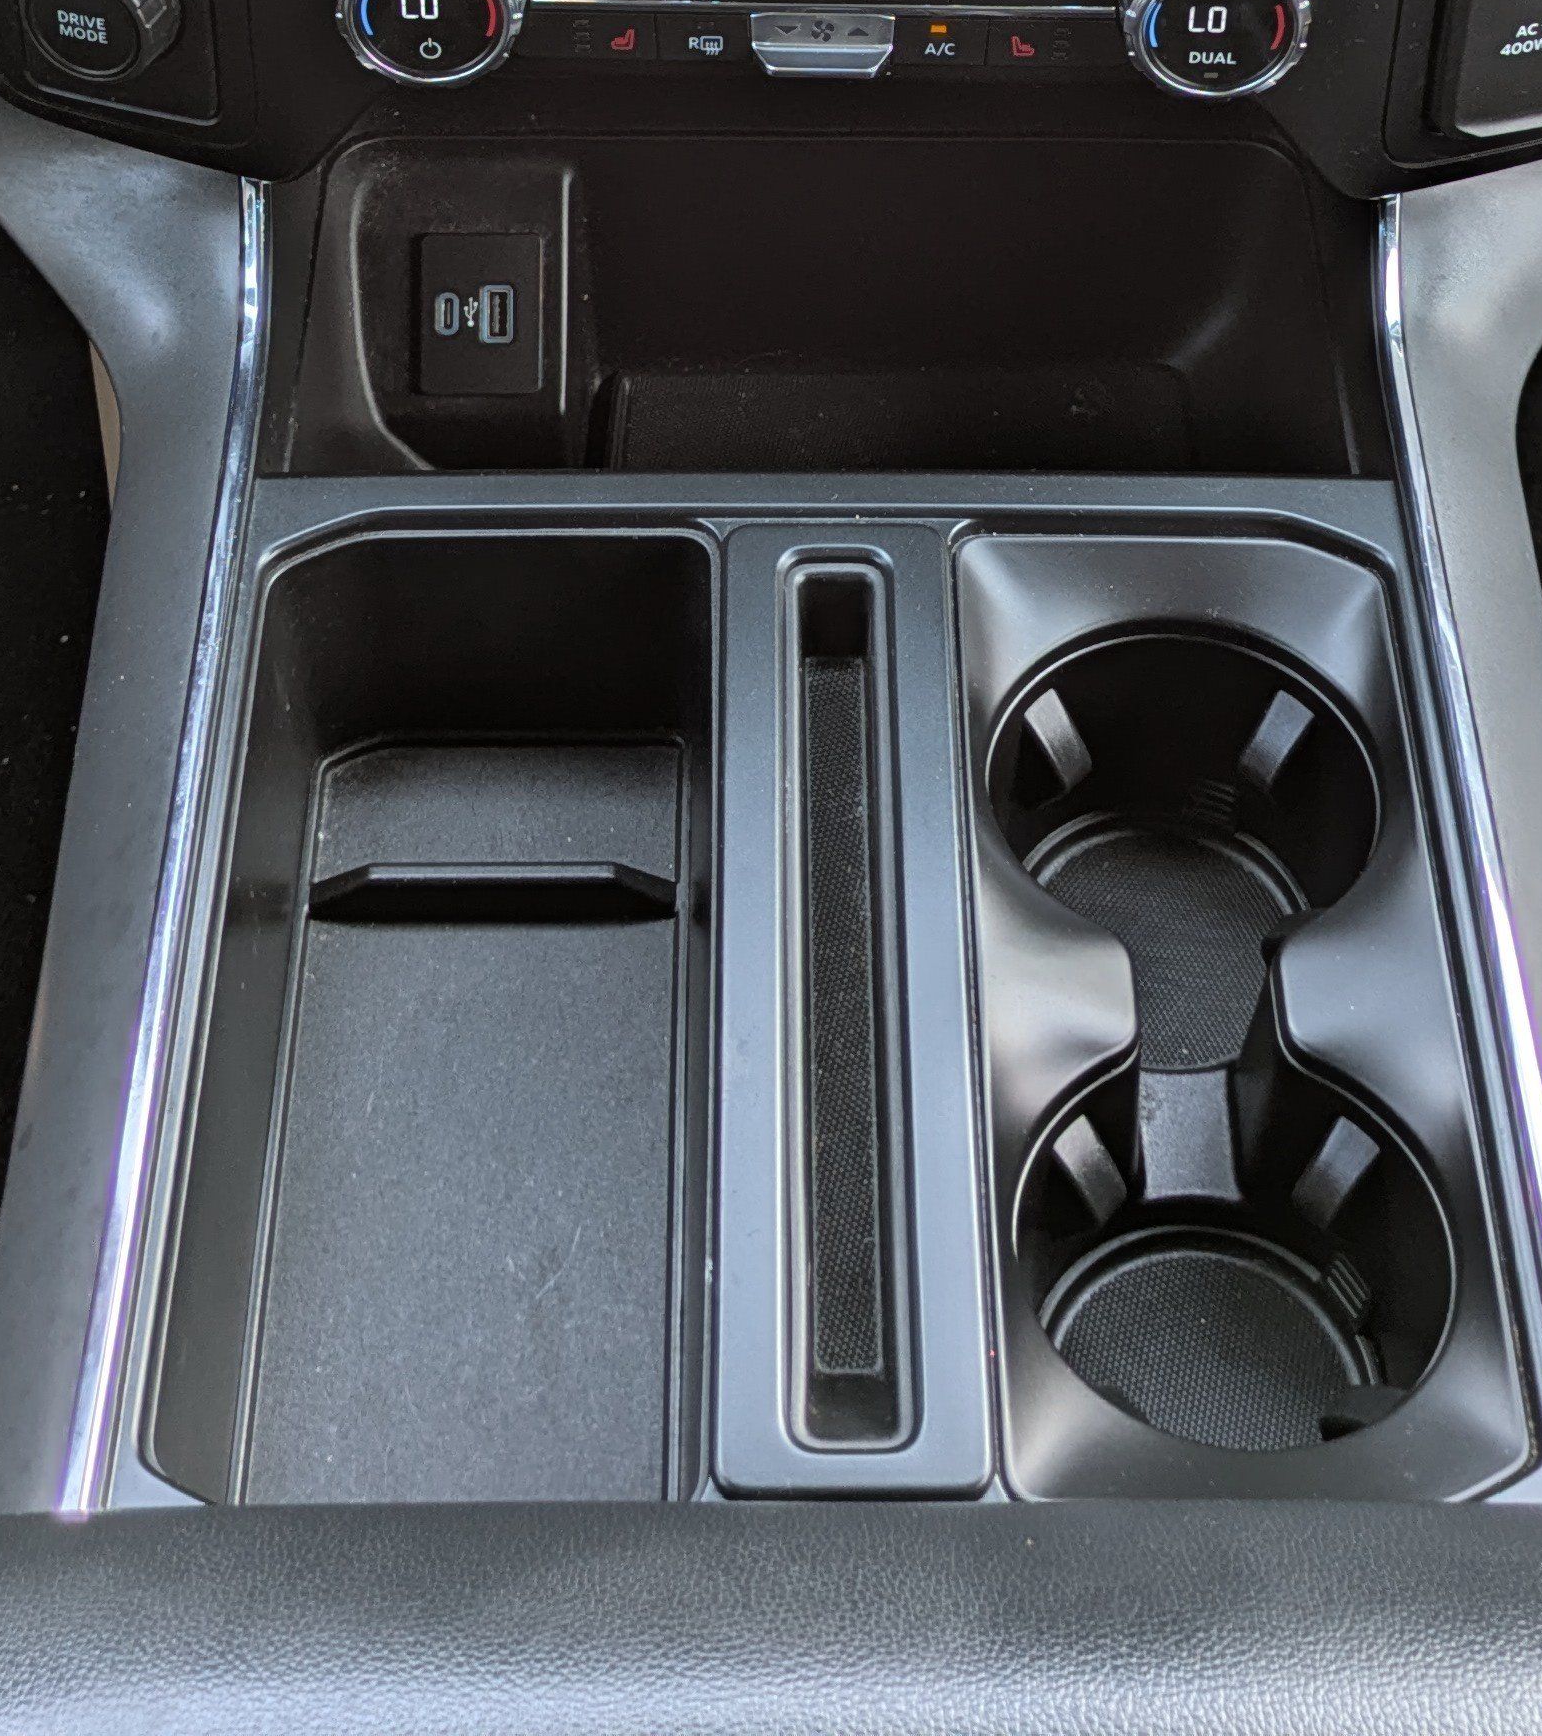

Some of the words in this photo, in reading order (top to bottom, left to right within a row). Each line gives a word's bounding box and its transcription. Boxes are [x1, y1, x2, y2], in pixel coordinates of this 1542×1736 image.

[57, 9, 106, 31] DRIVE
[59, 23, 108, 45] MODE
[1515, 21, 1539, 39] AC
[924, 42, 956, 57] A/C
[1188, 51, 1237, 65] DUAL
